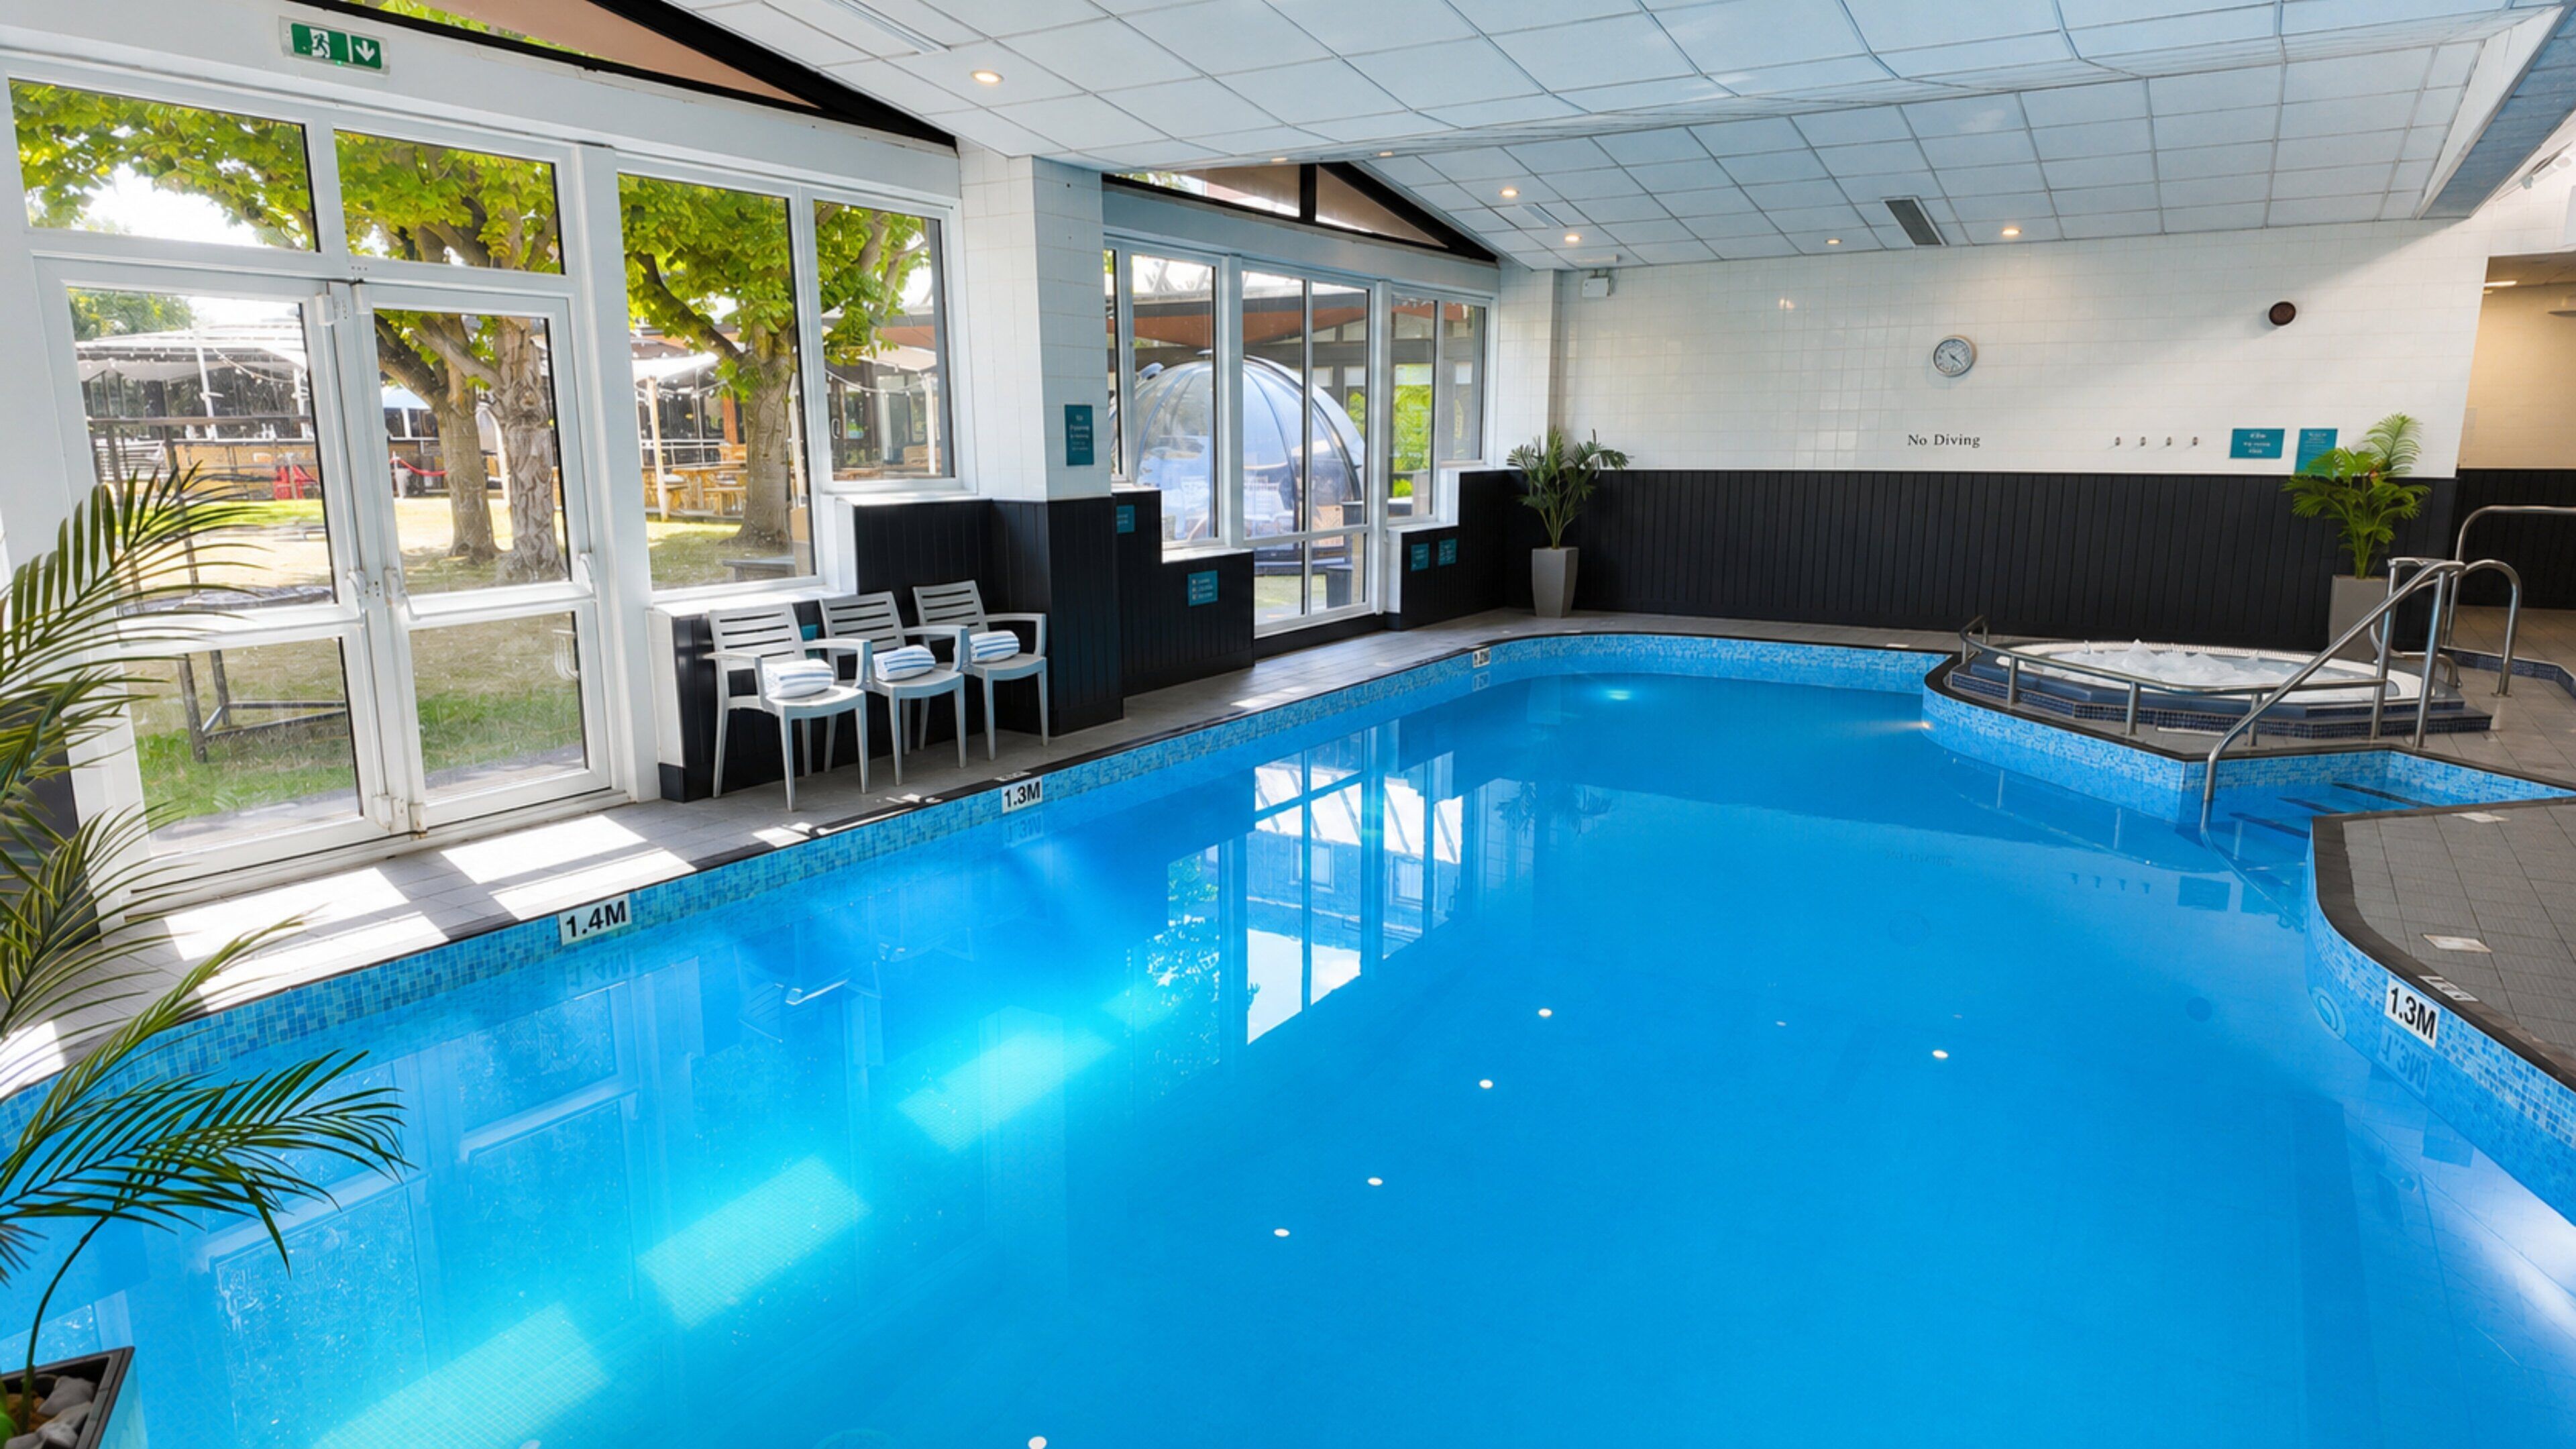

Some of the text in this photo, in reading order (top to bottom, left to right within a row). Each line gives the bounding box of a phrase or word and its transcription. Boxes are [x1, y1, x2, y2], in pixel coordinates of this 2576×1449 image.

[1907, 433, 1981, 449] No Diving
[1004, 782, 1040, 808] 1.3M
[566, 900, 627, 937] 1.4M
[2391, 987, 2436, 1040] 1.3M
